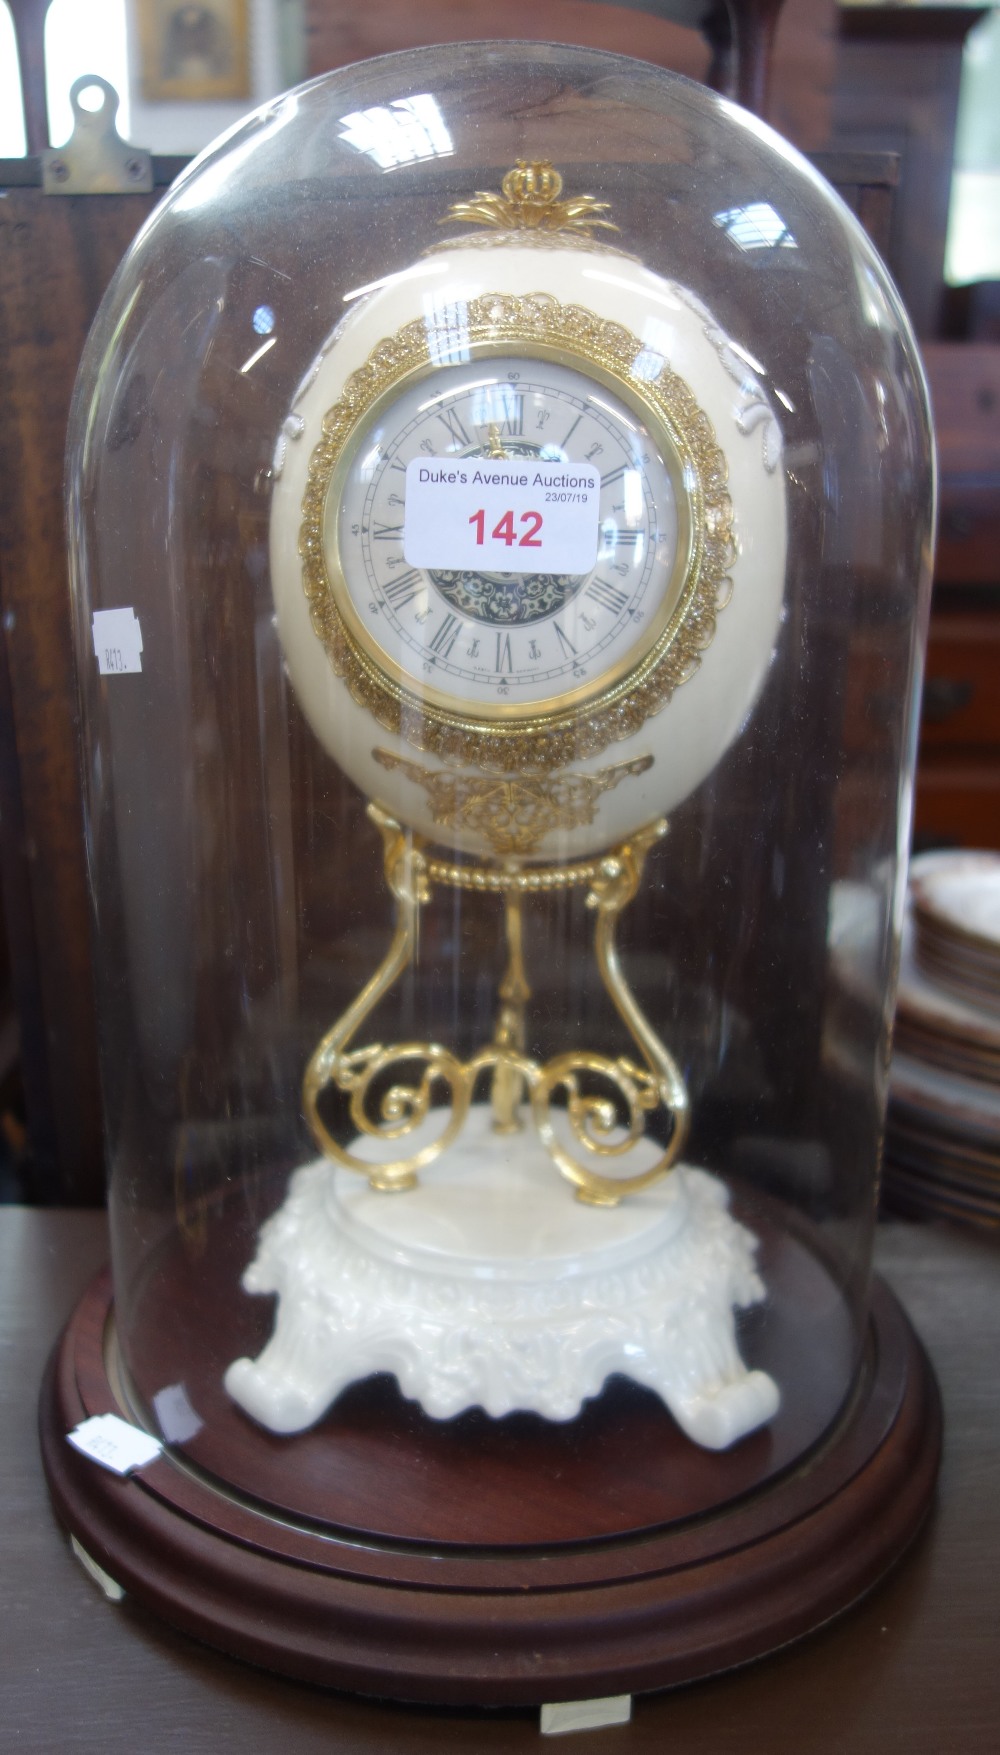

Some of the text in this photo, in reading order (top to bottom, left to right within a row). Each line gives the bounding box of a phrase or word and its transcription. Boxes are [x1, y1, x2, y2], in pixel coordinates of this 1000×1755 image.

[507, 372, 520, 381] 60
[499, 394, 526, 437] XII
[436, 406, 474, 453] XI
[418, 468, 595, 489] Duke's Avenue Auctions
[545, 492, 588, 504] 23/07/19
[468, 508, 544, 547] 142
[497, 685, 511, 696] 30
